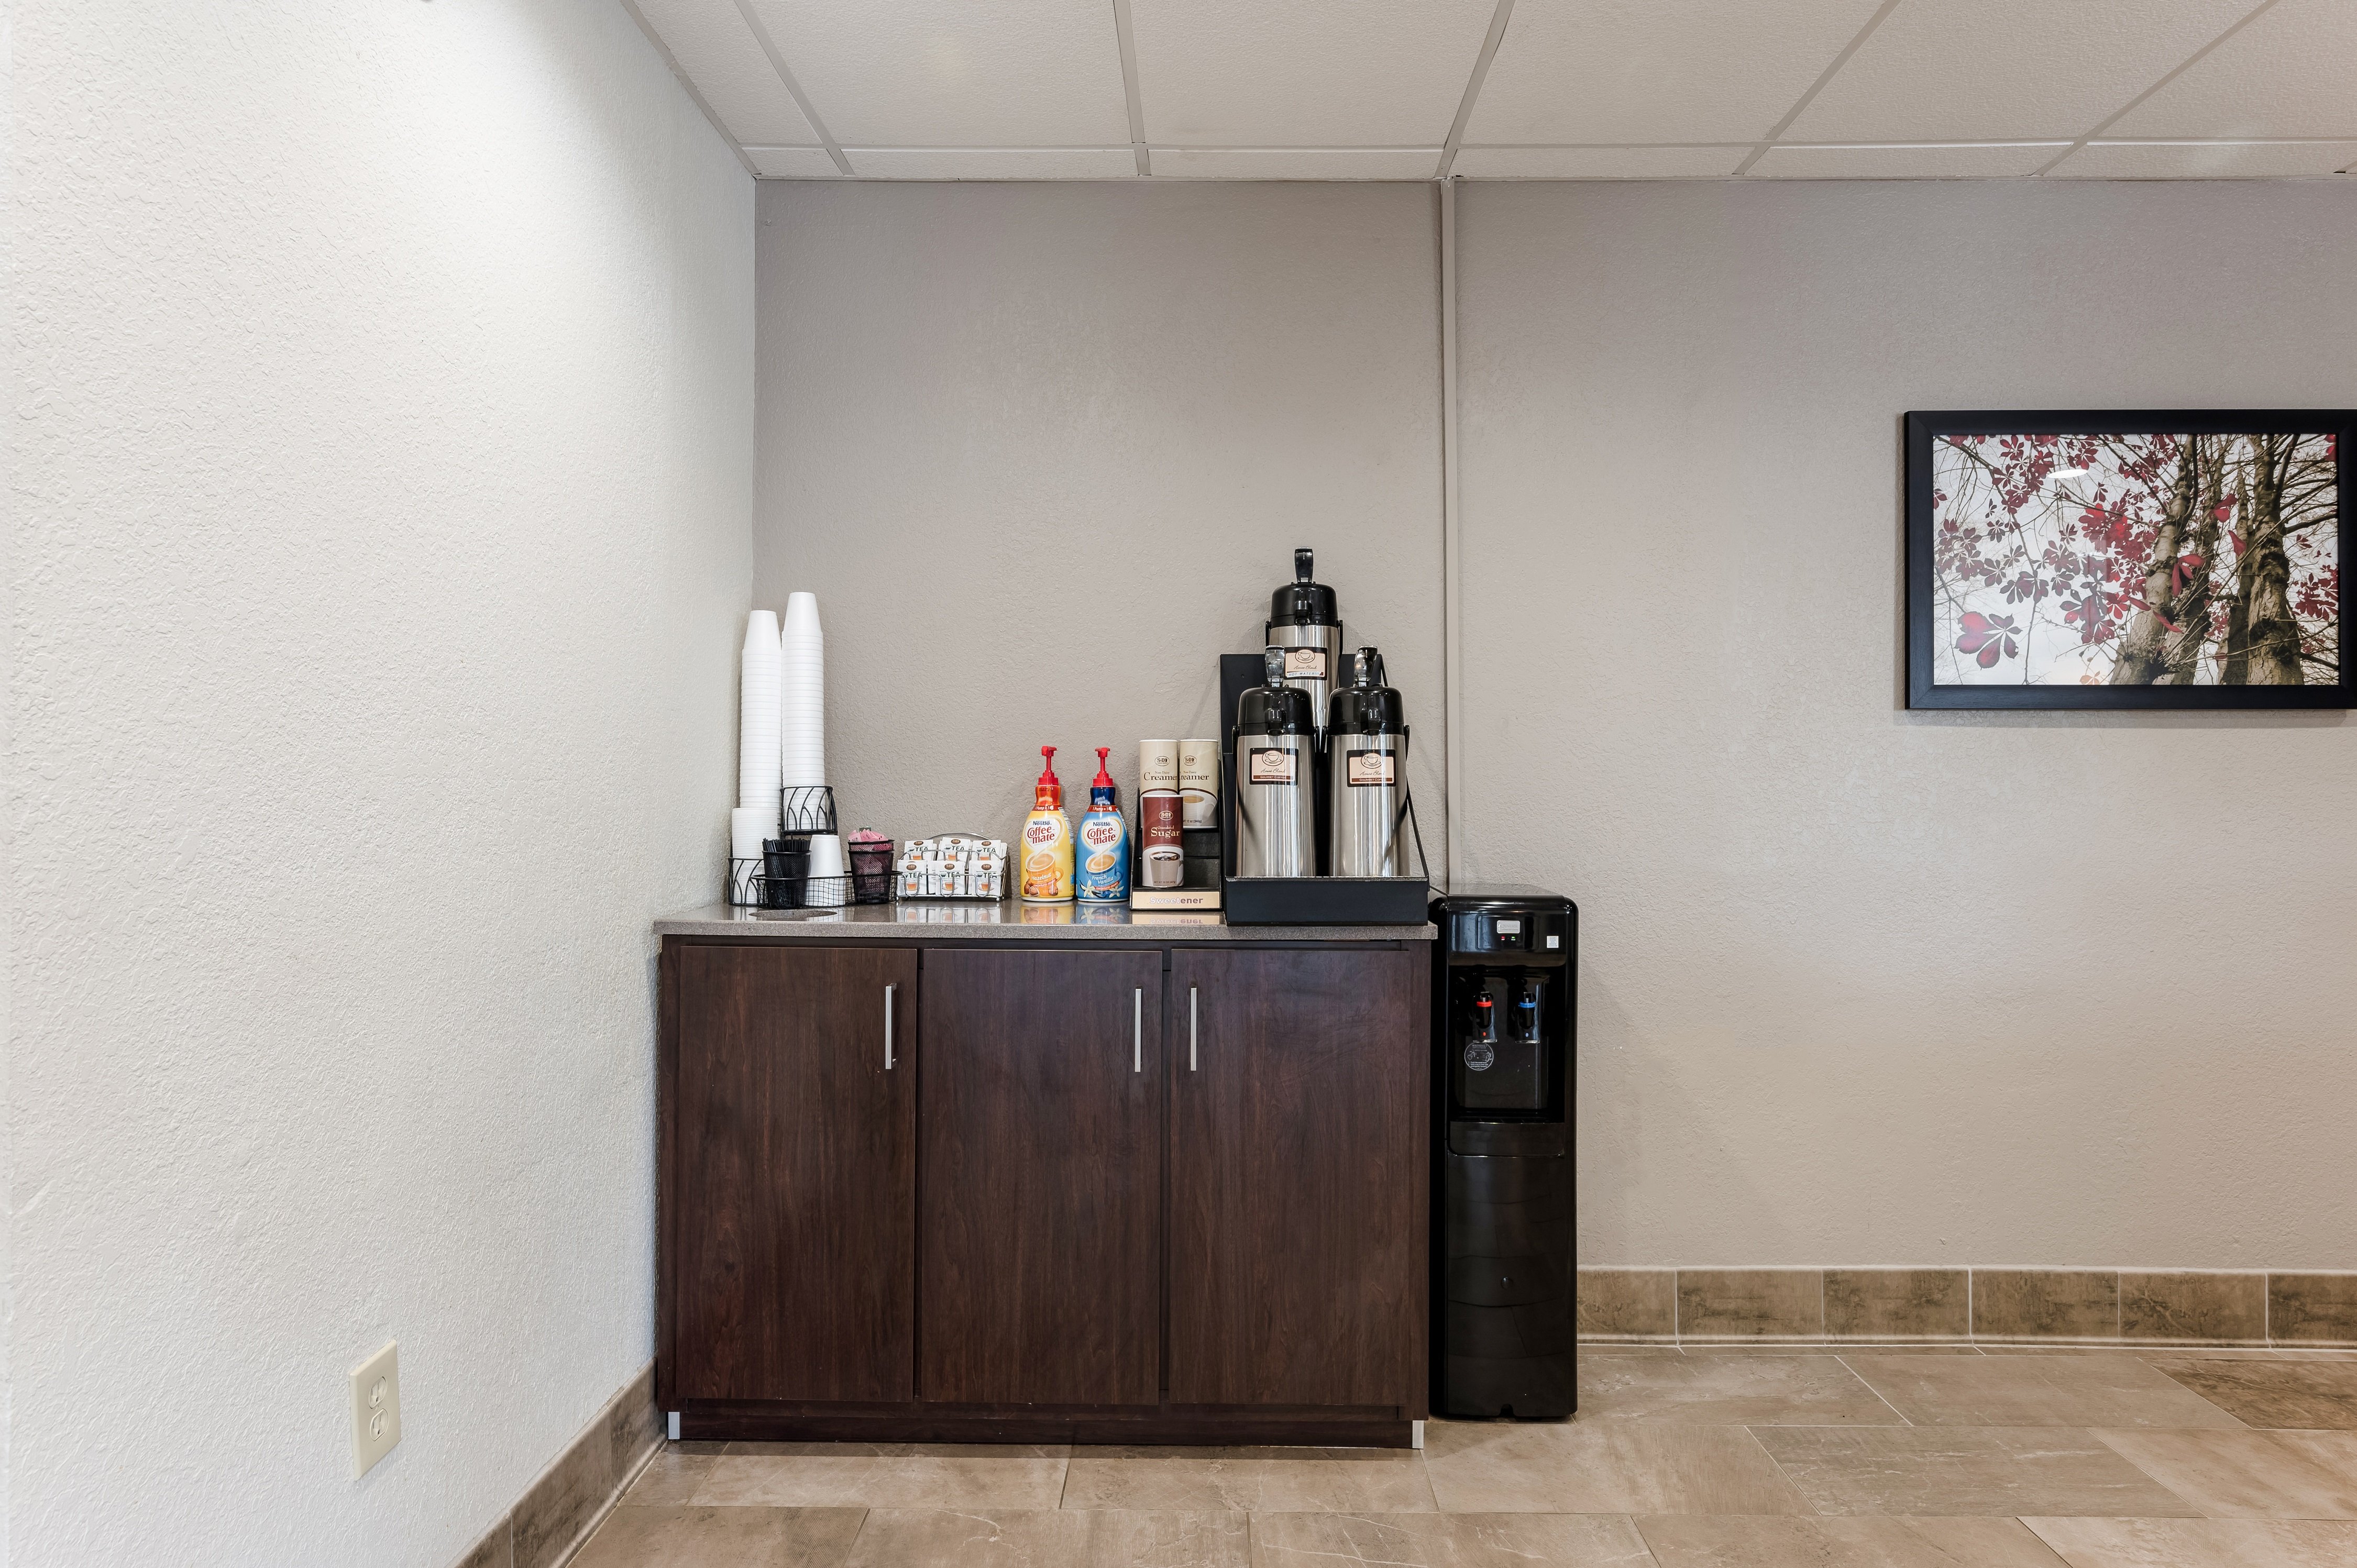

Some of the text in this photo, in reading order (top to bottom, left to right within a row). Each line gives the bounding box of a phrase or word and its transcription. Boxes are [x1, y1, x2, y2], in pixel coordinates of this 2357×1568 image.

[1144, 771, 1177, 780] Creamer
[1151, 827, 1180, 838] Sugar
[1032, 833, 1055, 844] mate
[1094, 834, 1116, 845] mate
[1150, 896, 1204, 904] Sweetener
